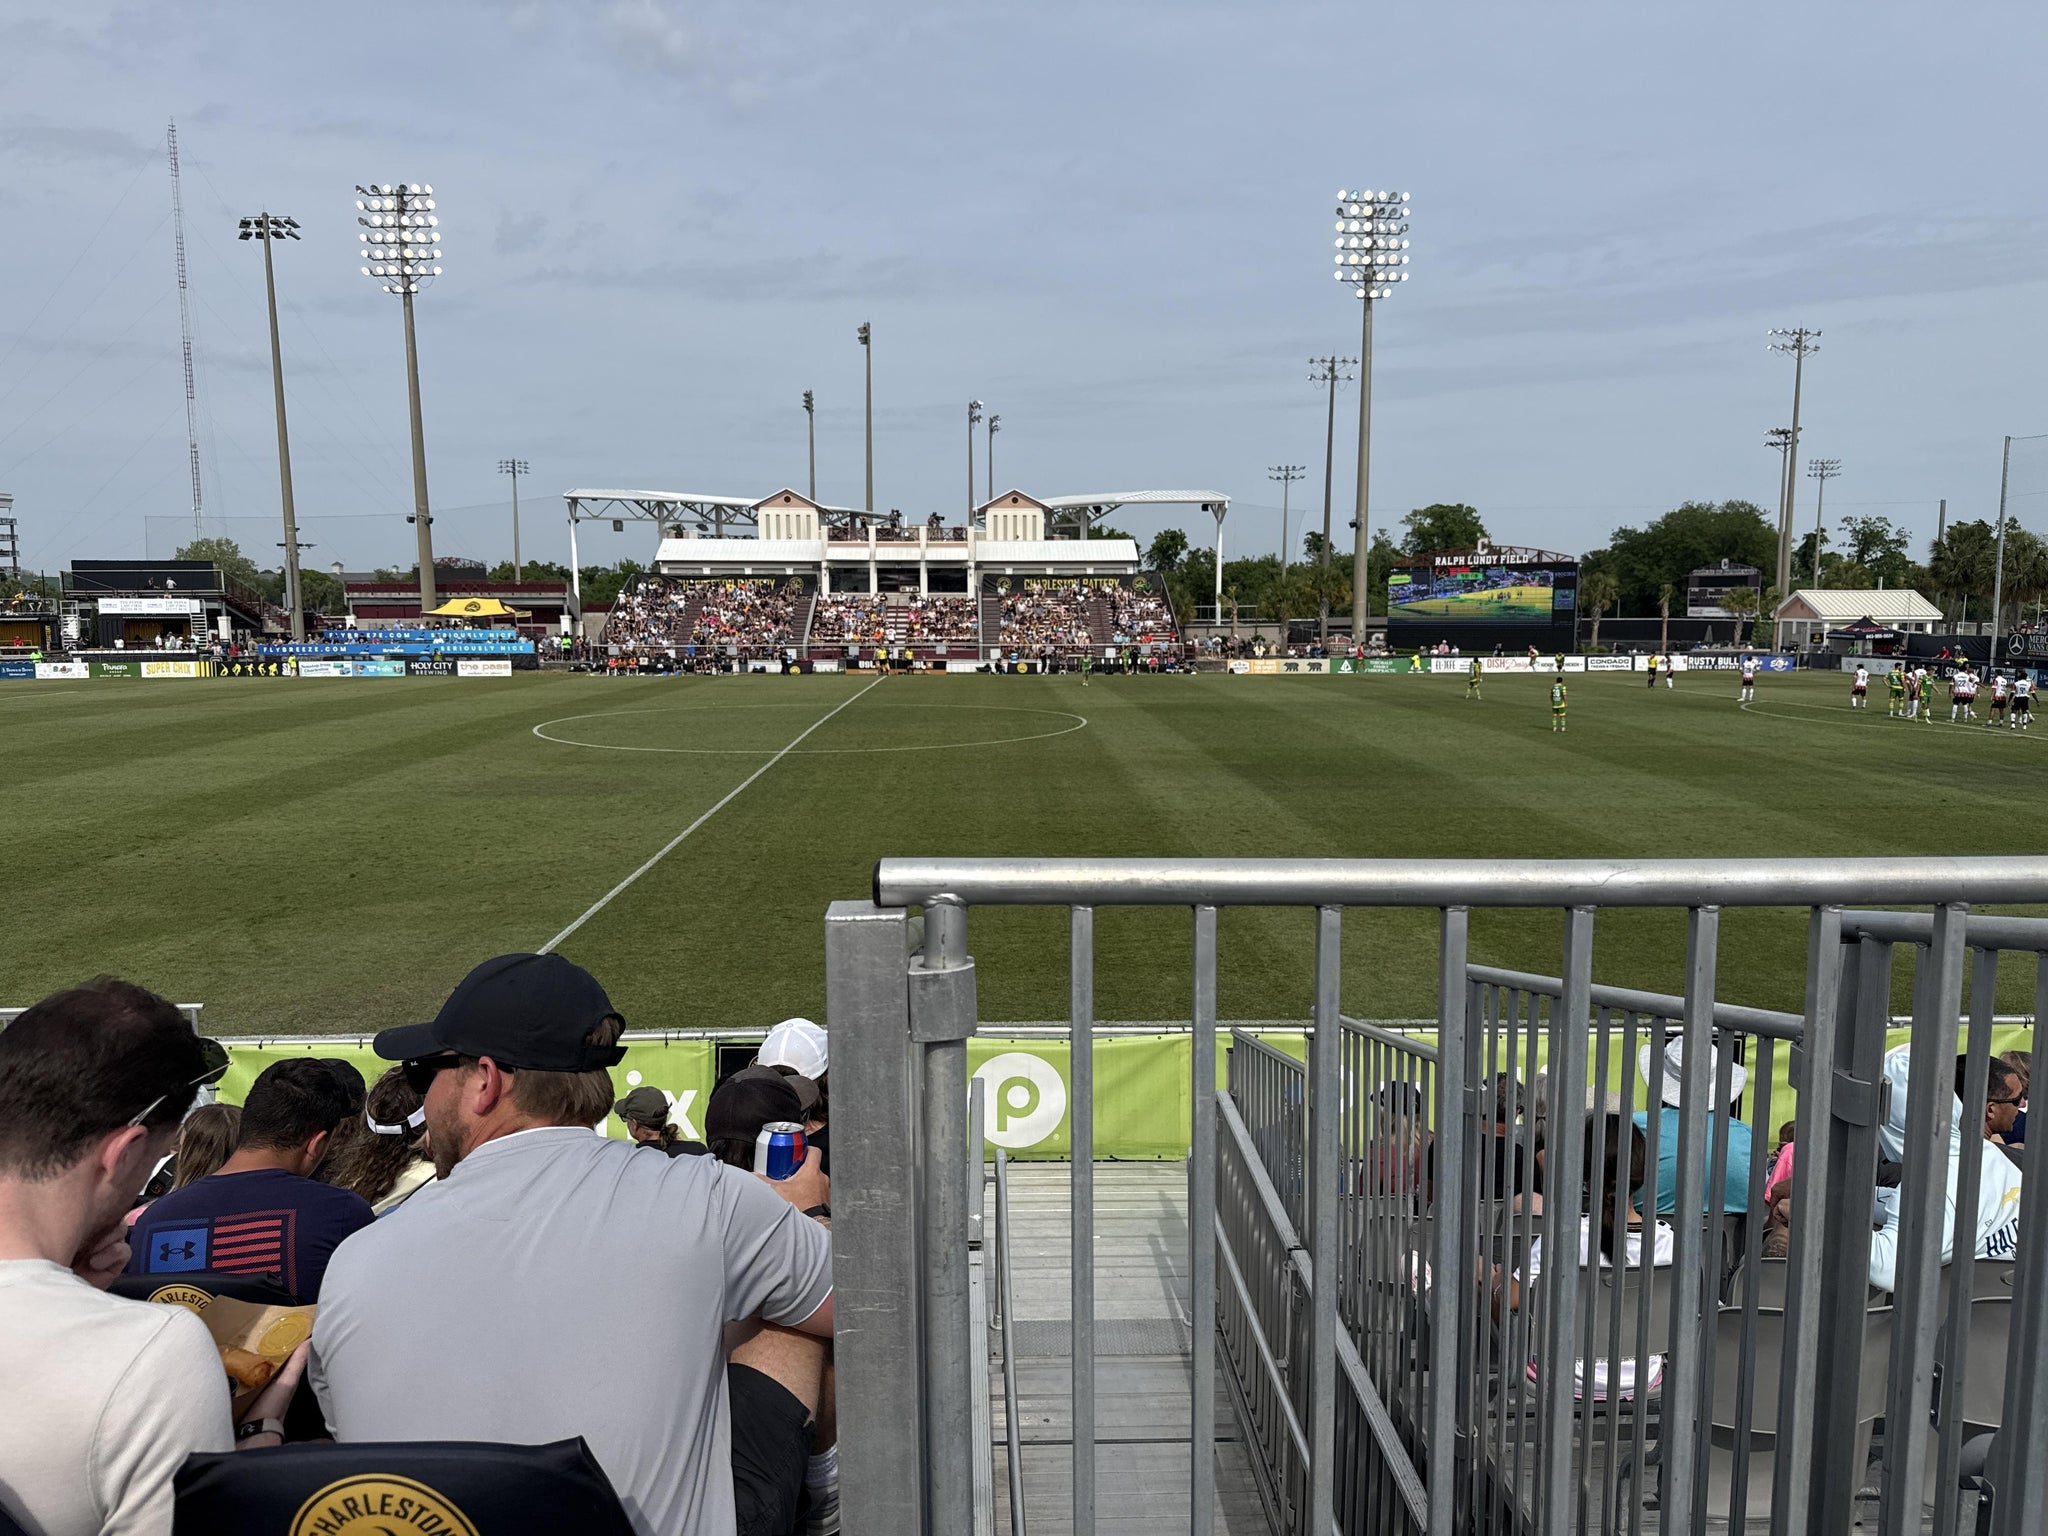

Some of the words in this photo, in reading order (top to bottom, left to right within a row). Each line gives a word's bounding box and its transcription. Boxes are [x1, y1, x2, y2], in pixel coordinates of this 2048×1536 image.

[1435, 556, 1465, 566] RALPH
[1467, 555, 1498, 565] LUNDY
[1500, 554, 1529, 564] FIELD
[1487, 659, 1505, 669] DISH
[1688, 657, 1716, 665] RUSTY
[1718, 657, 1739, 665] BULL
[146, 663, 170, 675] SUPER
[173, 662, 192, 674] CHIX
[410, 662, 433, 670] HOLY
[434, 662, 453, 670] CITY
[482, 664, 509, 672] pass
